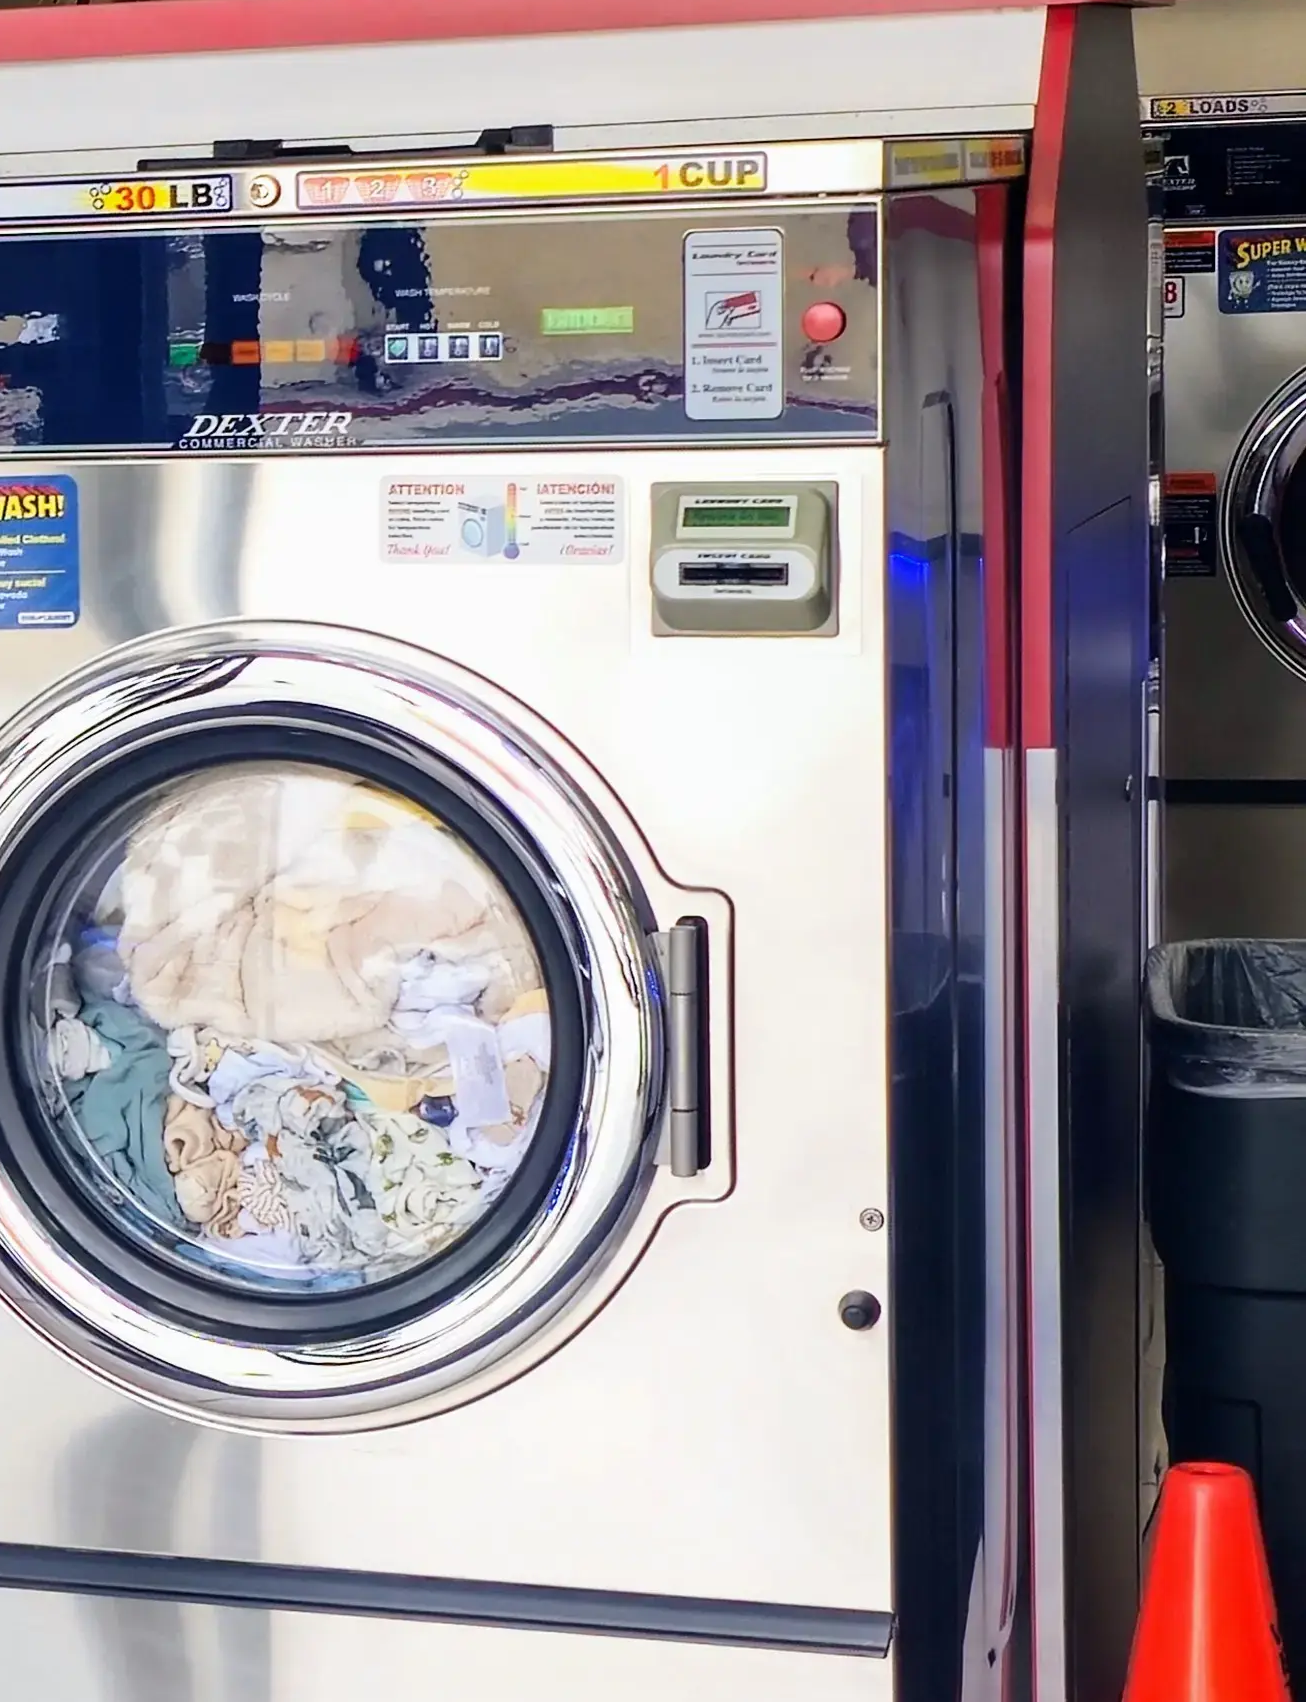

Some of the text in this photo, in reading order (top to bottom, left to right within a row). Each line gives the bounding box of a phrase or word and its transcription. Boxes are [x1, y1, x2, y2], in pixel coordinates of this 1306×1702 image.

[1167, 99, 1249, 114] 2 LOADS
[653, 166, 669, 191] 1
[678, 159, 759, 188] CUP
[115, 186, 155, 211] 30
[170, 184, 213, 208] LB
[1237, 239, 1292, 270] SUPER
[183, 412, 353, 437] DEXTER
[179, 436, 357, 450] COMMERCIAL WASHER
[388, 483, 464, 495] ATTENTION
[0, 547, 23, 557] Wash
